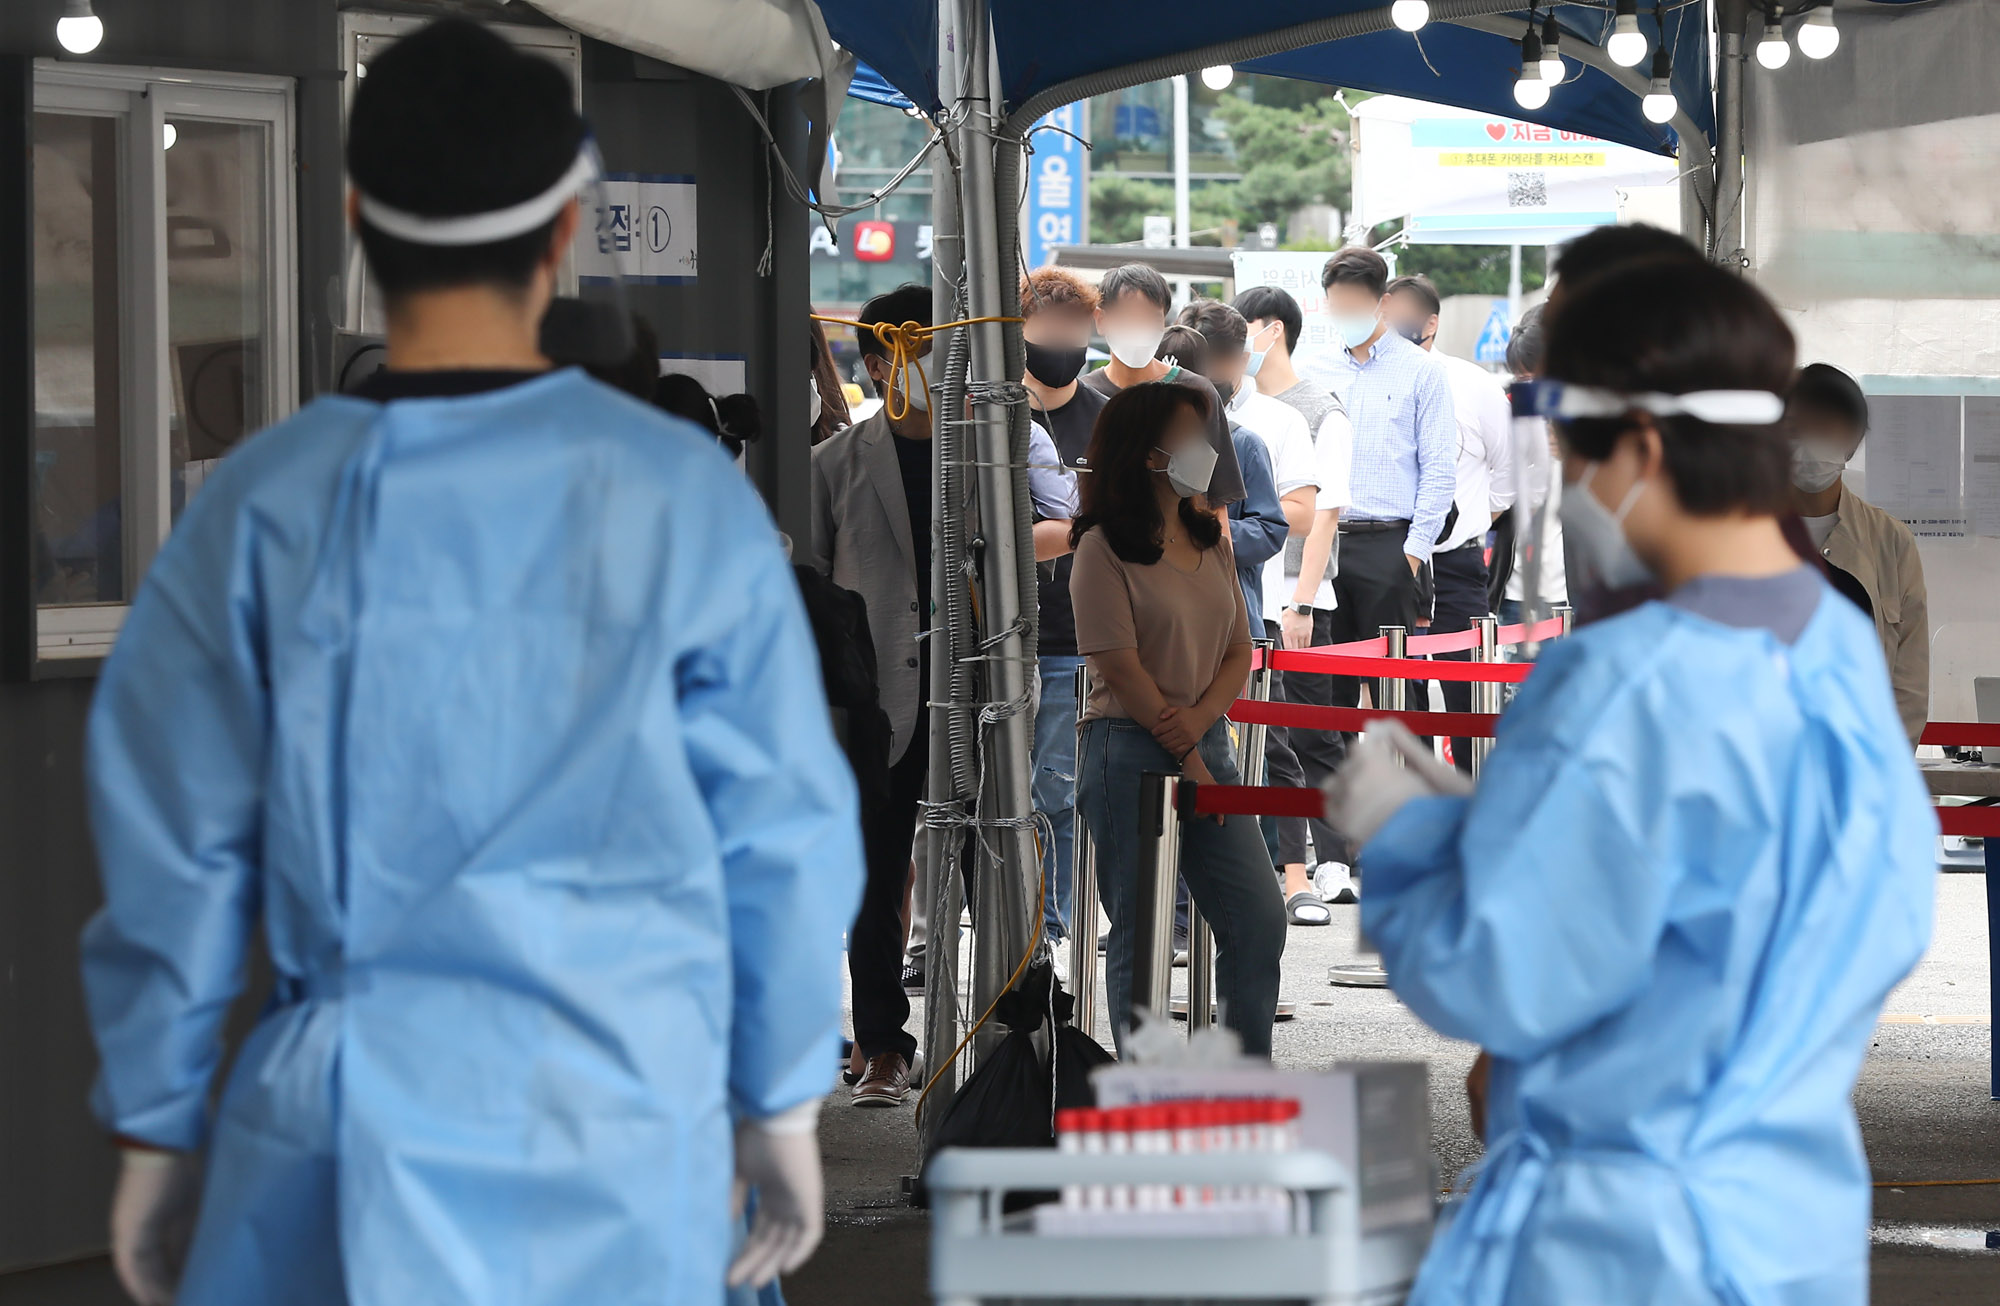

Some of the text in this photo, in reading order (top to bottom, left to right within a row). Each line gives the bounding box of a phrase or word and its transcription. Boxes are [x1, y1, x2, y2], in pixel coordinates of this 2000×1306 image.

[1512, 122, 1552, 142] 지금
[1466, 153, 1496, 165] 휴대폰
[1500, 153, 1543, 165] 카메라를
[1548, 153, 1569, 165] 켜서
[1572, 153, 1594, 165] 스캔
